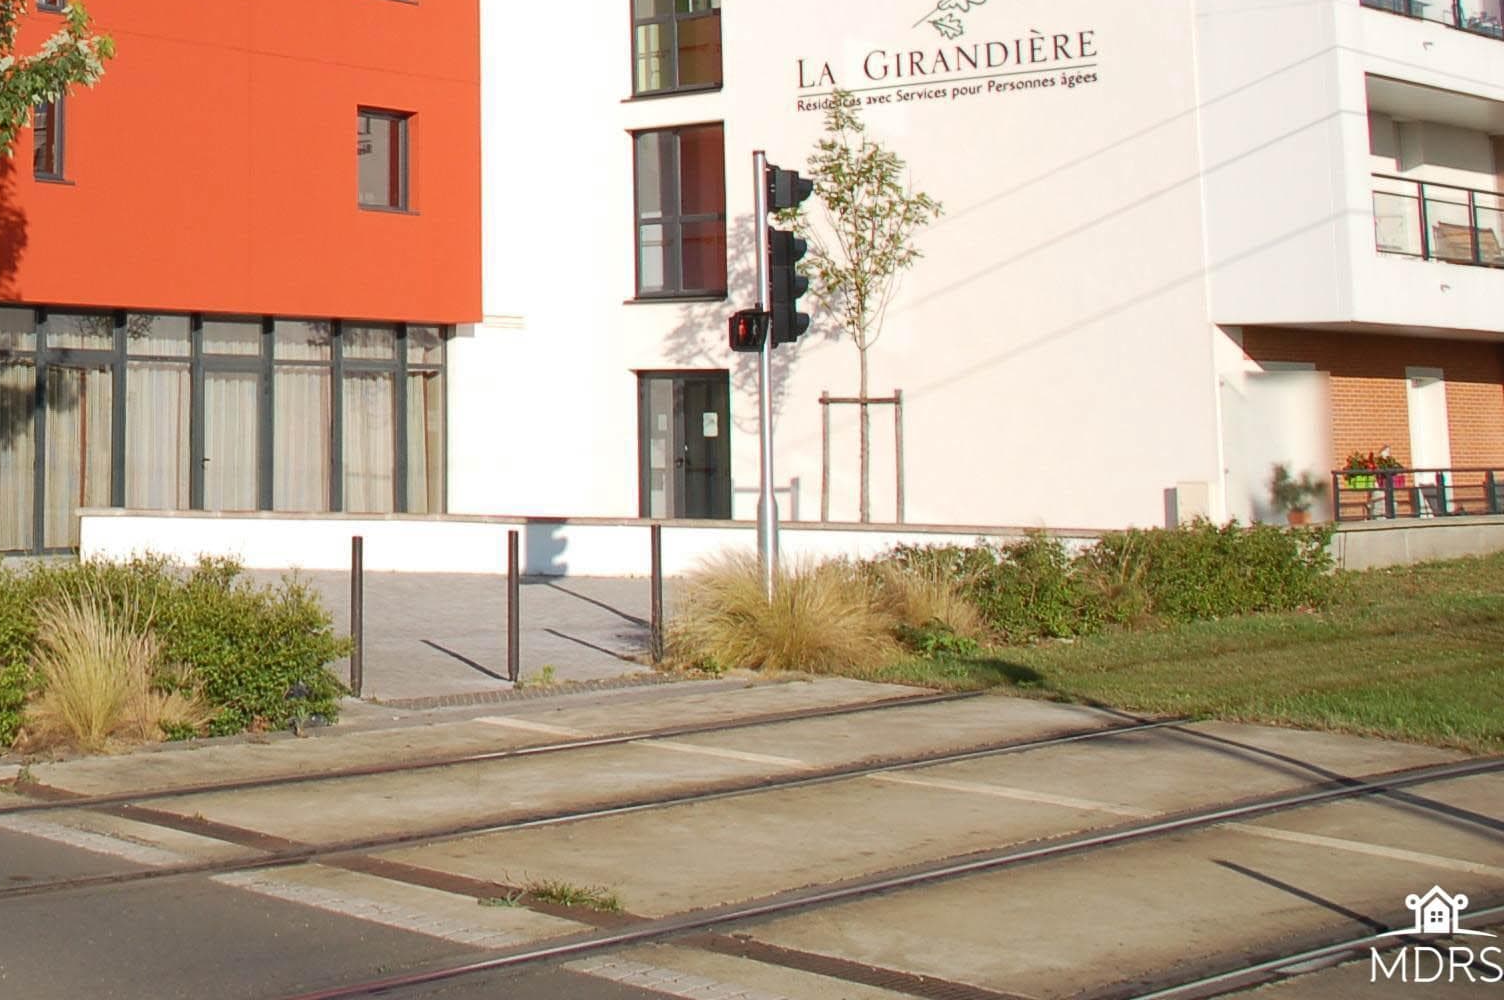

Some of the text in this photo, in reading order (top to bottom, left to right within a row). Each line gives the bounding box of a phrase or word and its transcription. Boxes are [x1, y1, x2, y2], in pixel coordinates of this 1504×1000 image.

[797, 28, 1097, 88] LA GIRANDIÈRE
[866, 94, 892, 105] avec
[896, 89, 947, 102] Services
[952, 84, 983, 100] pour
[987, 78, 1056, 93] Personnes
